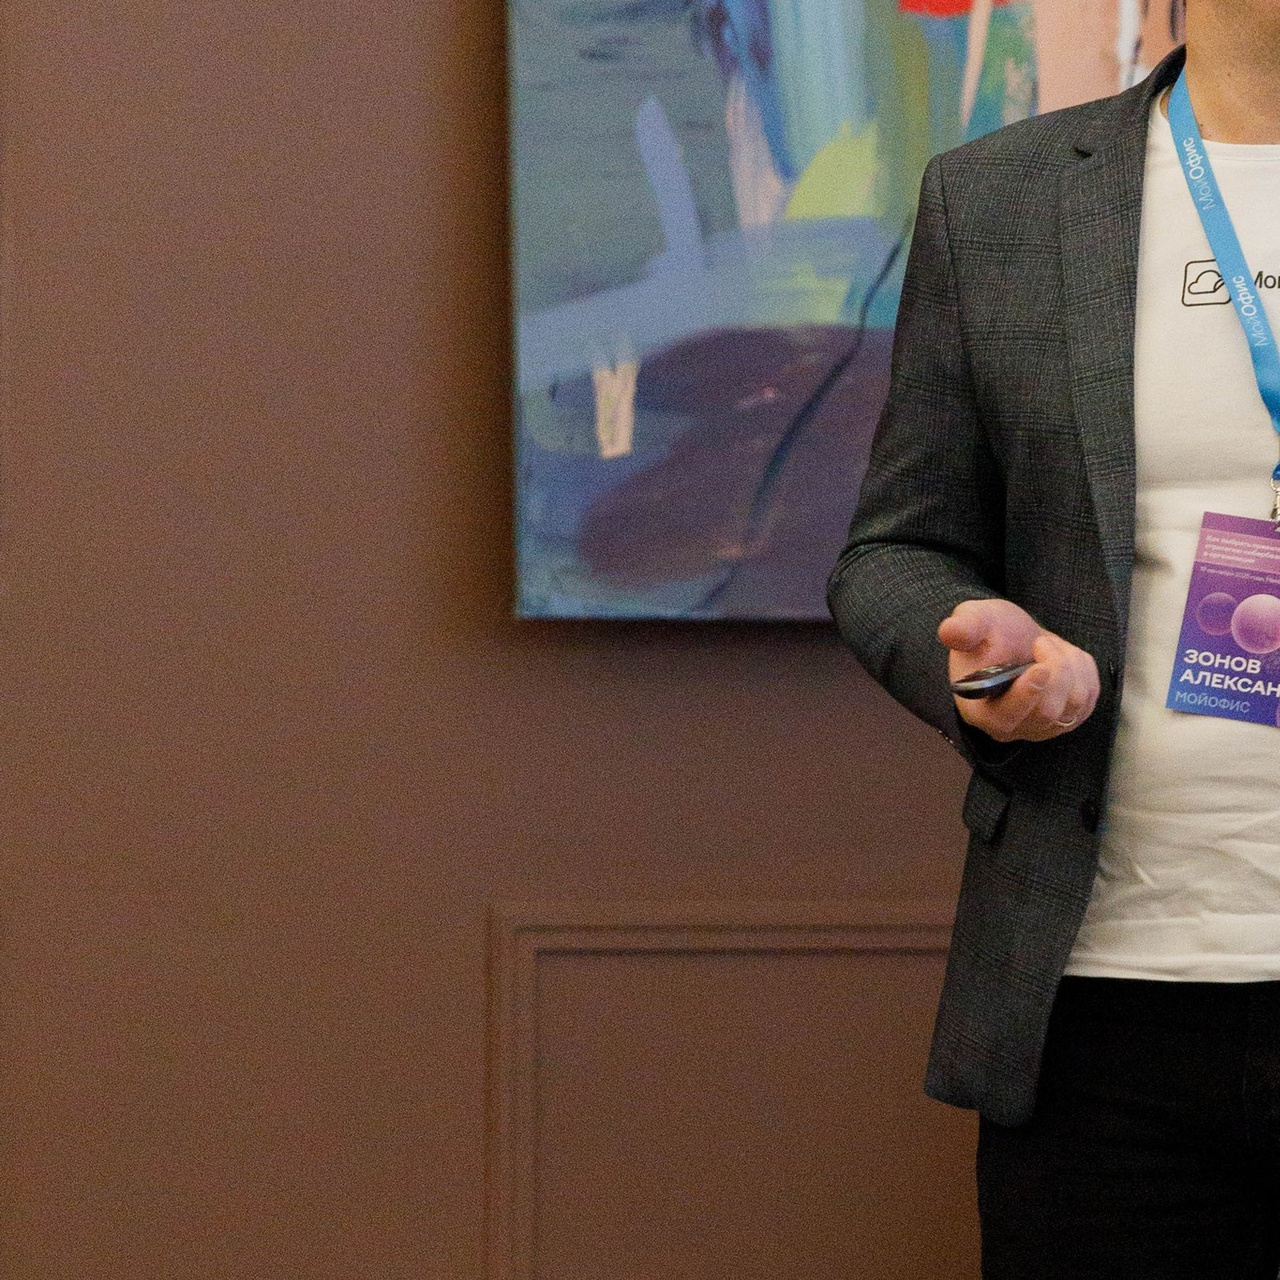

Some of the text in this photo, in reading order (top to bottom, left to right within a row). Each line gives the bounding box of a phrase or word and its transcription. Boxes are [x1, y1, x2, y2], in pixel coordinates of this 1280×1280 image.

[1183, 136, 1216, 211] МойОфис
[1232, 274, 1270, 348] МойОфис
[1183, 648, 1262, 674] ЗОНОВ
[1174, 690, 1251, 714] МОЙОФИС
